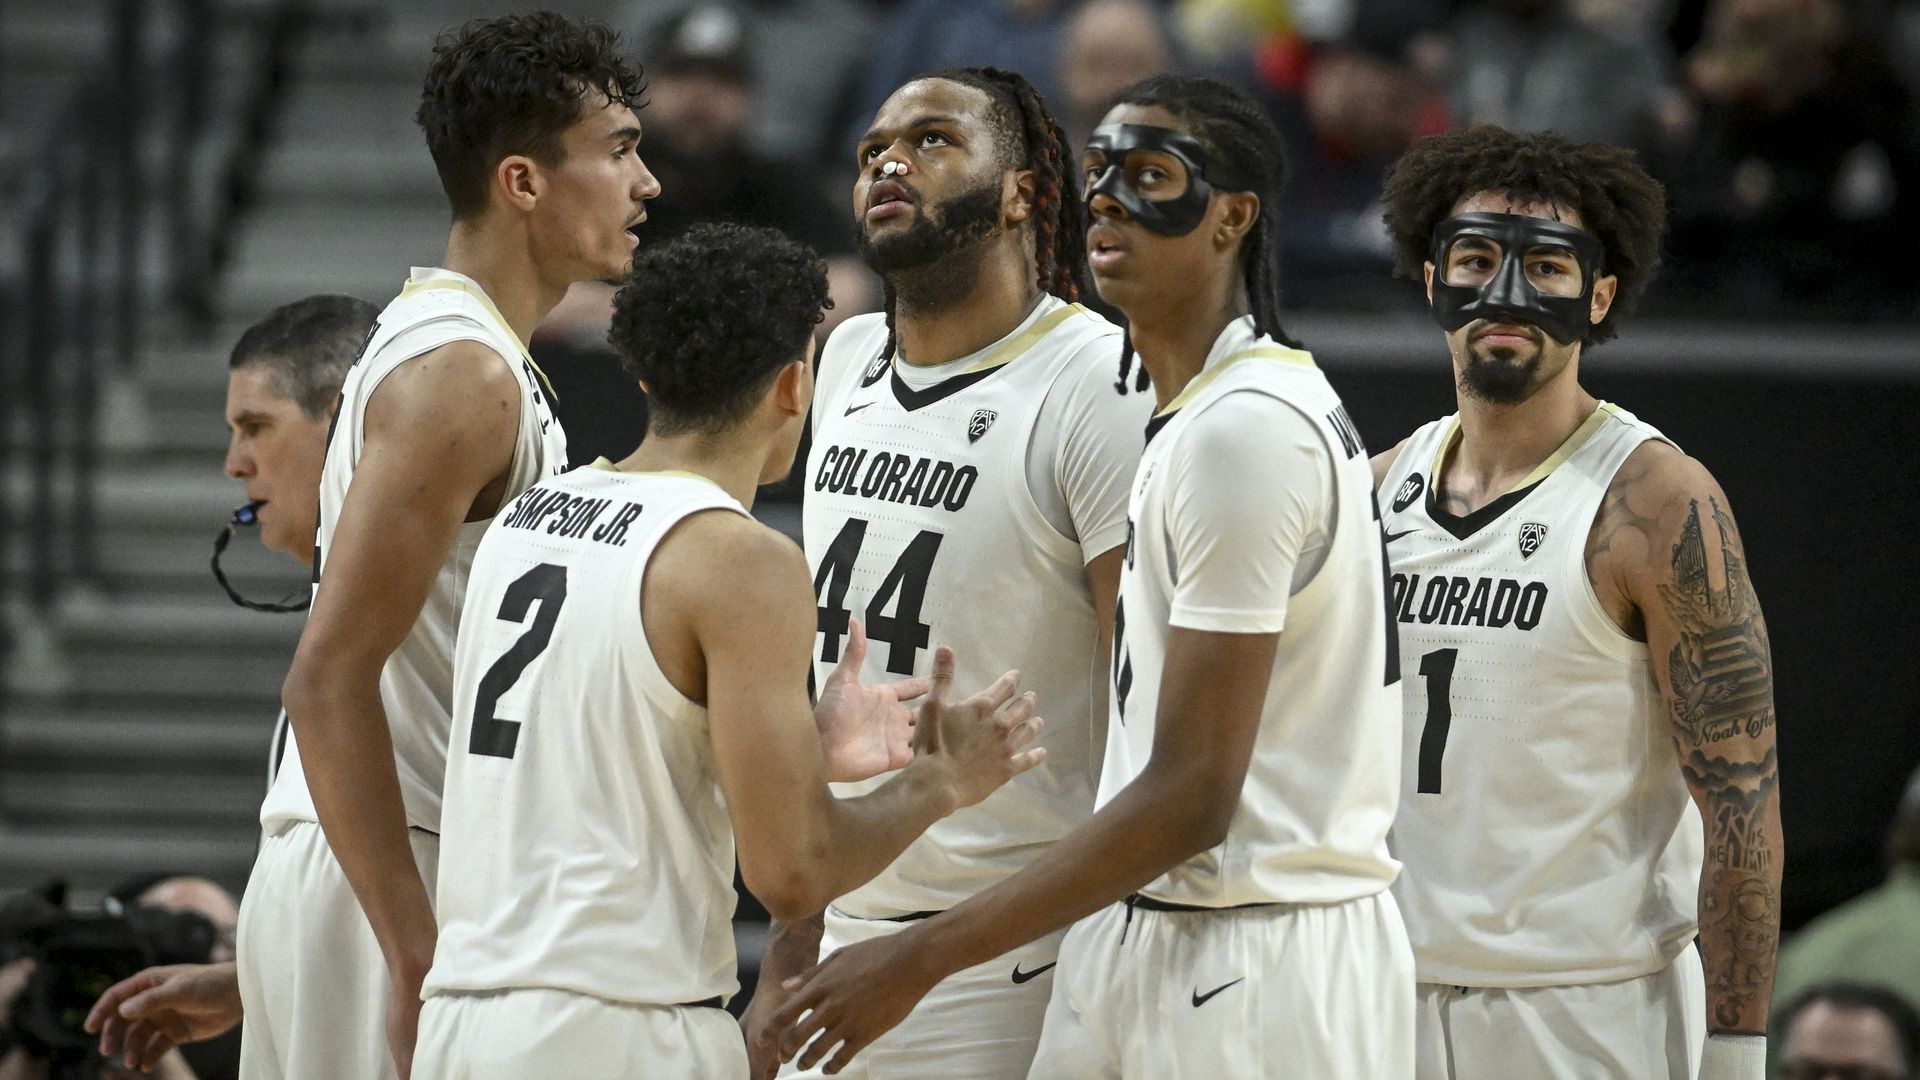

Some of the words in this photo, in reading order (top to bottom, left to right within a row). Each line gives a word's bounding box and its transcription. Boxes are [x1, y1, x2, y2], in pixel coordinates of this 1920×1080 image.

[970, 410, 996, 430] PAC
[970, 423, 981, 436] 12
[814, 445, 979, 512] COLORADO
[1396, 480, 1420, 502] BH
[503, 487, 612, 539] SIMPSON
[592, 502, 643, 547] JR.
[1519, 523, 1548, 545] PAC
[1521, 538, 1536, 552] 12
[813, 517, 944, 676] 44
[1391, 573, 1549, 631] OLORADO
[468, 562, 568, 760] 2
[1417, 648, 1459, 794] 1
[1693, 718, 1742, 747] Noah
